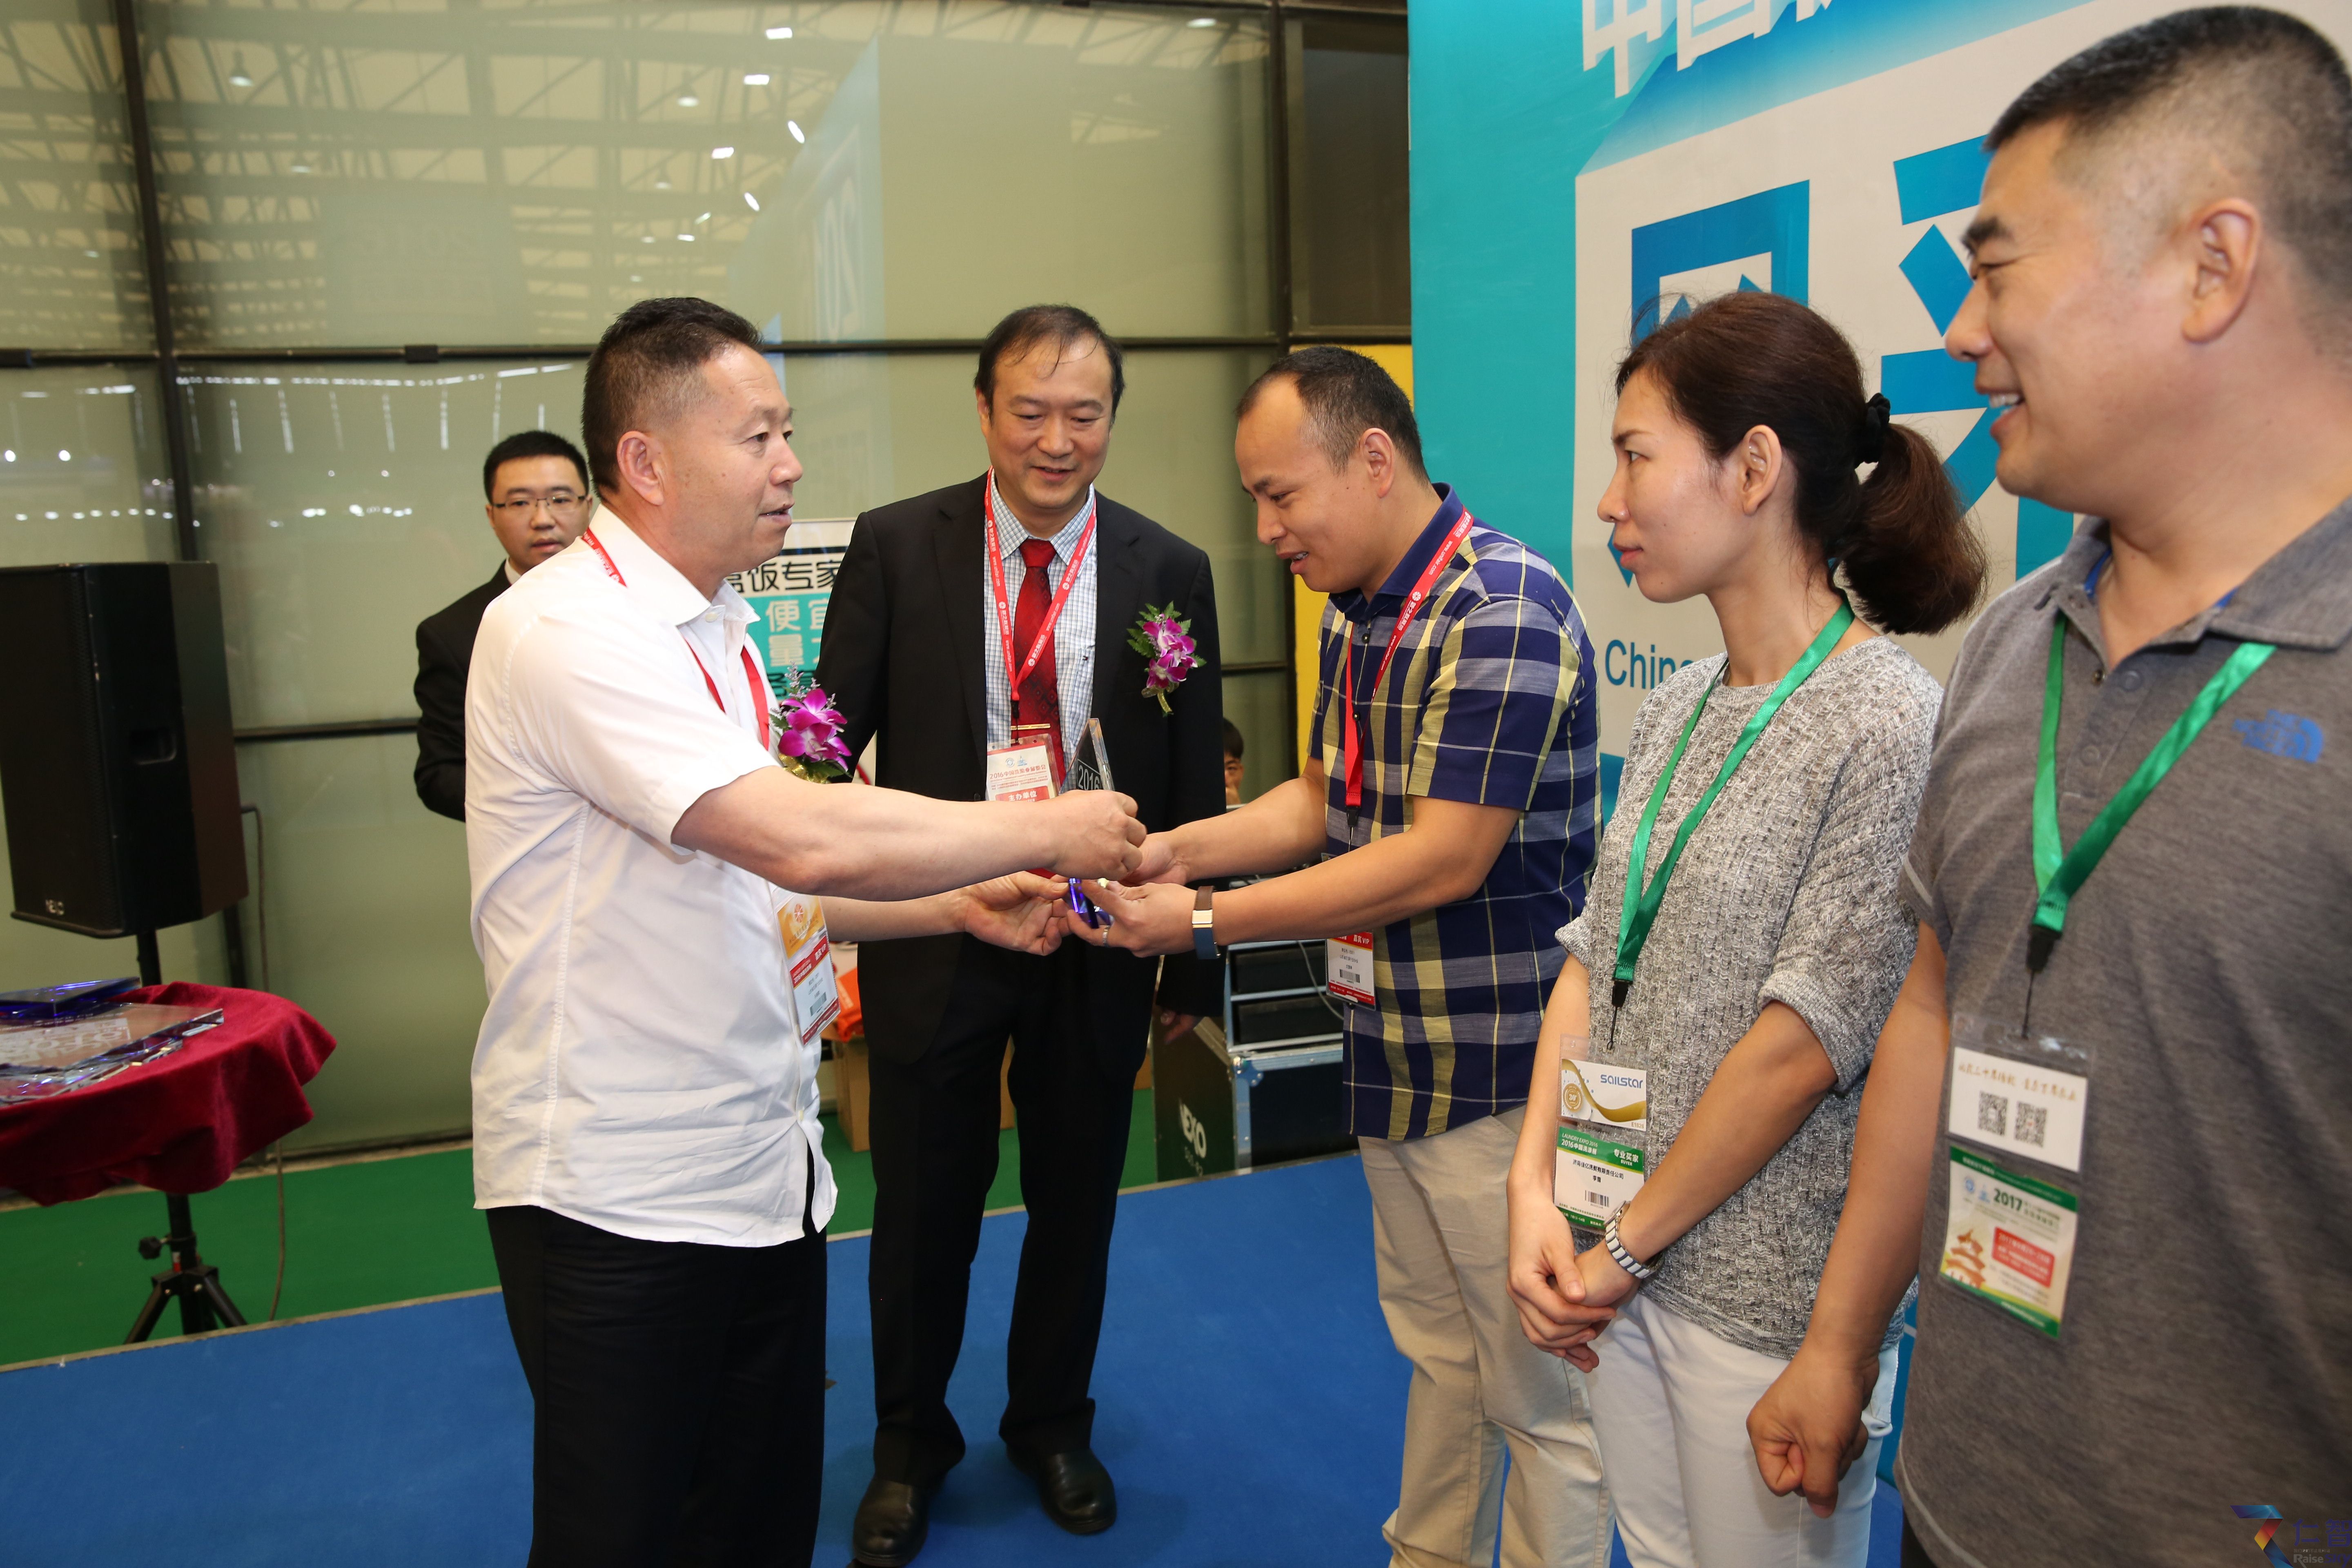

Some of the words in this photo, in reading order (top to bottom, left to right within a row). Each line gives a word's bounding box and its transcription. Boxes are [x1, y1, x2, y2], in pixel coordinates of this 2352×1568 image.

[1605, 639, 1693, 689] Chin
[1078, 765, 1100, 791] 2016
[1008, 791, 1037, 802] 主办单位
[1562, 1133, 1579, 1141] LAUNDRY
[1614, 1148, 1639, 1163] 专业买家
[1993, 1188, 2024, 1214] 2017
